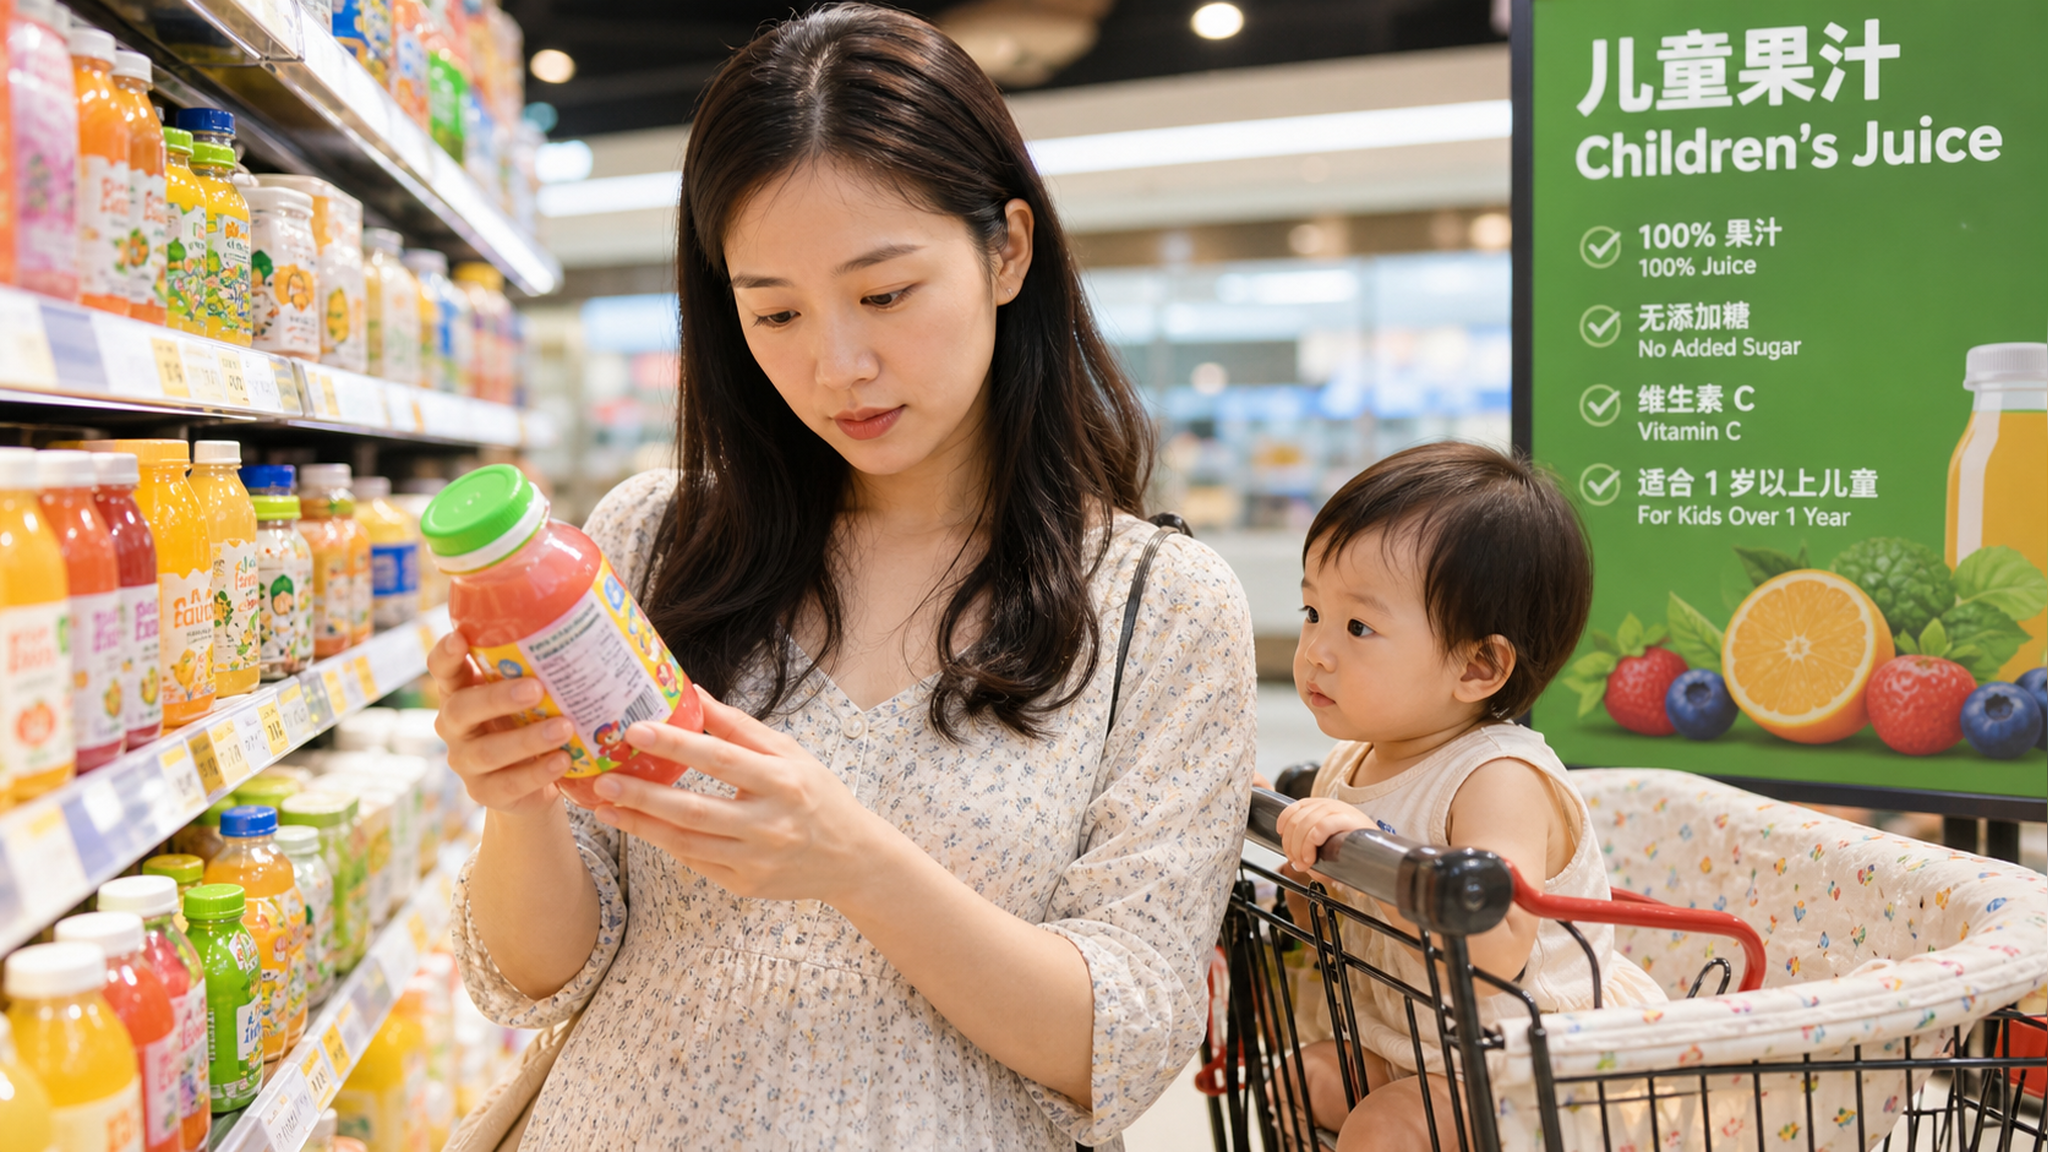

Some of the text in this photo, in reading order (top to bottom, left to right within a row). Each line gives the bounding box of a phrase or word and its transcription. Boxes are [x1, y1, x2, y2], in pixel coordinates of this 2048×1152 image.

[1576, 18, 1901, 118] 儿童果汁
[1575, 115, 2003, 180] Children’s Juice
[1638, 216, 1783, 250] 100% 果汁
[1638, 255, 1757, 278] 100% Juice
[1638, 300, 1751, 333] 无添加糖
[1638, 336, 1802, 361] No Added Sugar
[1637, 383, 1756, 415] 维生素 C
[1637, 420, 1742, 441] Vitamin C
[1637, 466, 1879, 499] 适合 1 岁以上儿童
[1637, 504, 1852, 527] For Kids Over 1 Year
